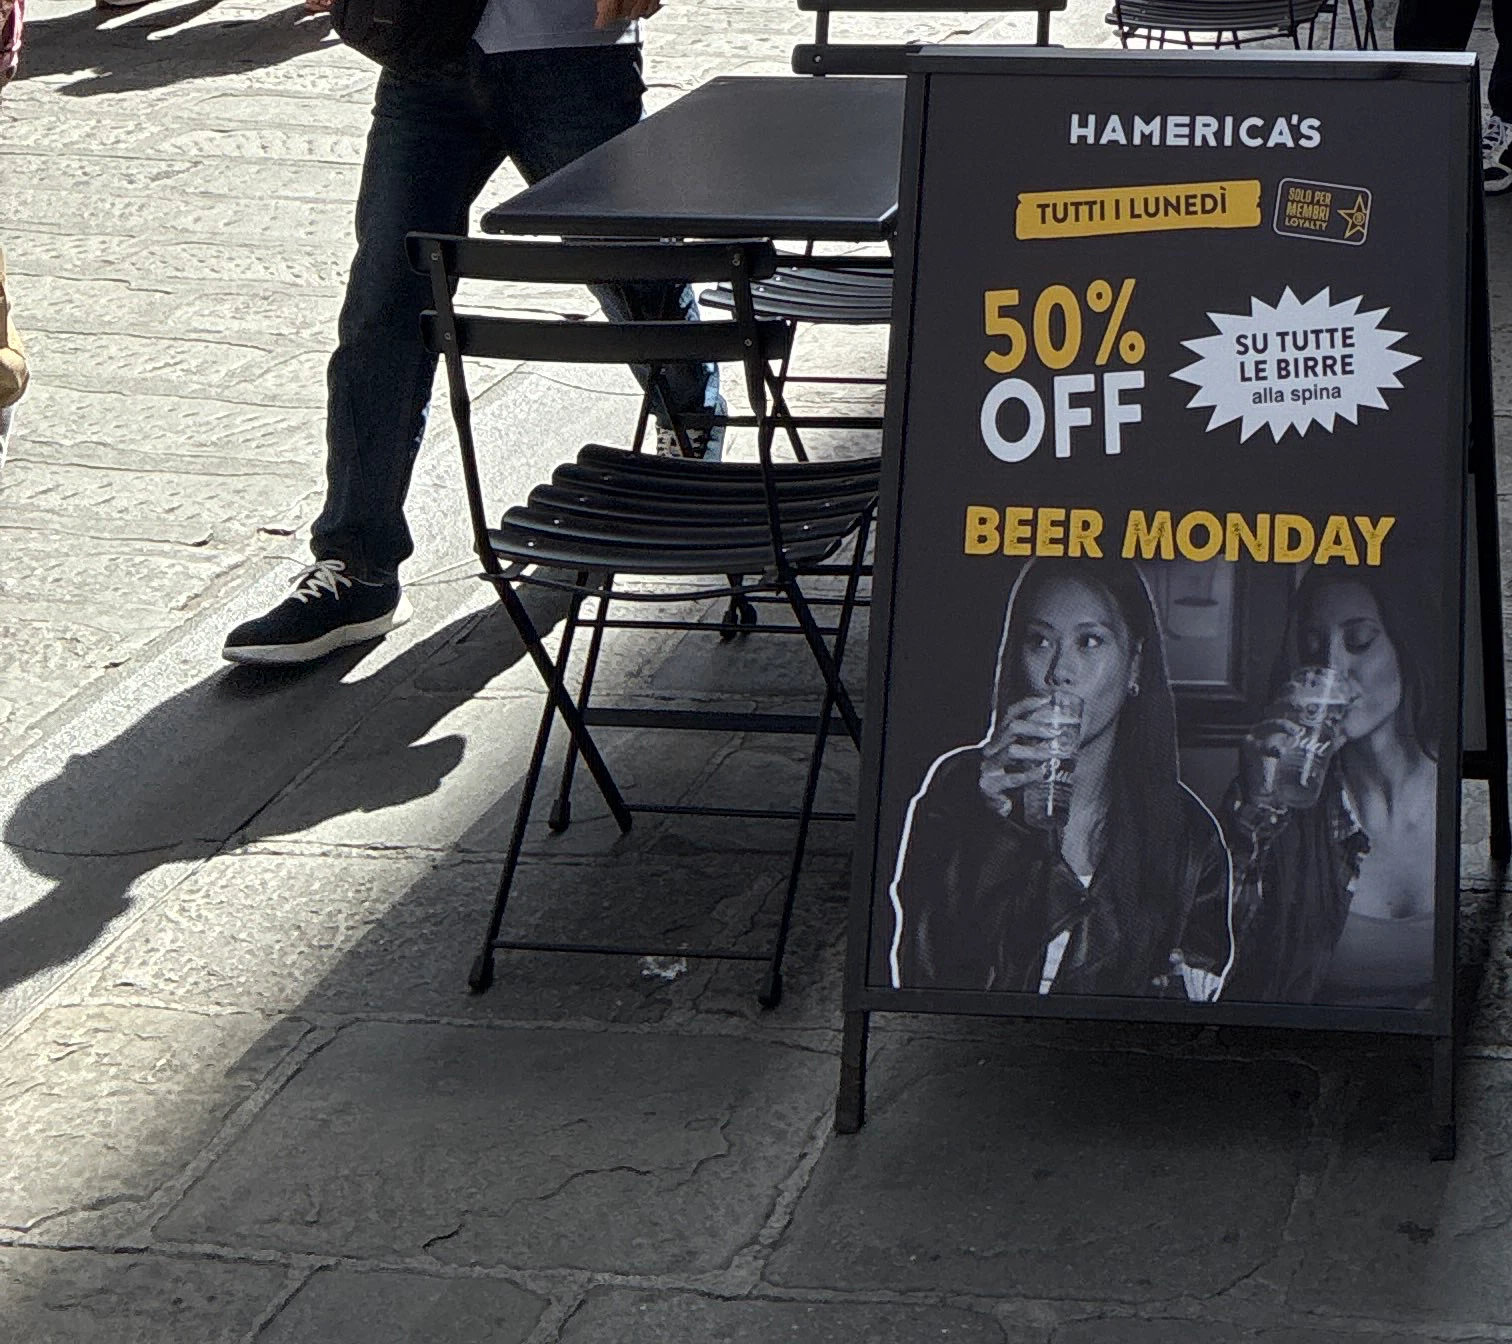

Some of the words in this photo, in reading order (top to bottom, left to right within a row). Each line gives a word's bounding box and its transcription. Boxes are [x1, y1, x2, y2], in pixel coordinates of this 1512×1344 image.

[1067, 112, 1323, 149] HAMERICA'S
[1036, 198, 1105, 225] TUTTI
[1115, 196, 1122, 220] I
[1129, 185, 1228, 219] LUNEDÌ
[1286, 201, 1330, 221] MEMBRI
[1288, 187, 1312, 203] SOLO
[1313, 191, 1332, 206] PER
[1284, 217, 1328, 231] LOYALTY
[983, 278, 1146, 374] 50%
[1235, 332, 1269, 355] SU
[1275, 326, 1356, 354] TUTTE
[1239, 358, 1269, 382] LE
[1275, 353, 1356, 380] BIRRE
[1251, 385, 1286, 406] alla
[1289, 382, 1343, 408] spina
[980, 369, 1146, 463] OFF
[964, 505, 1104, 558] BEER
[1120, 509, 1396, 566] MONDAY
